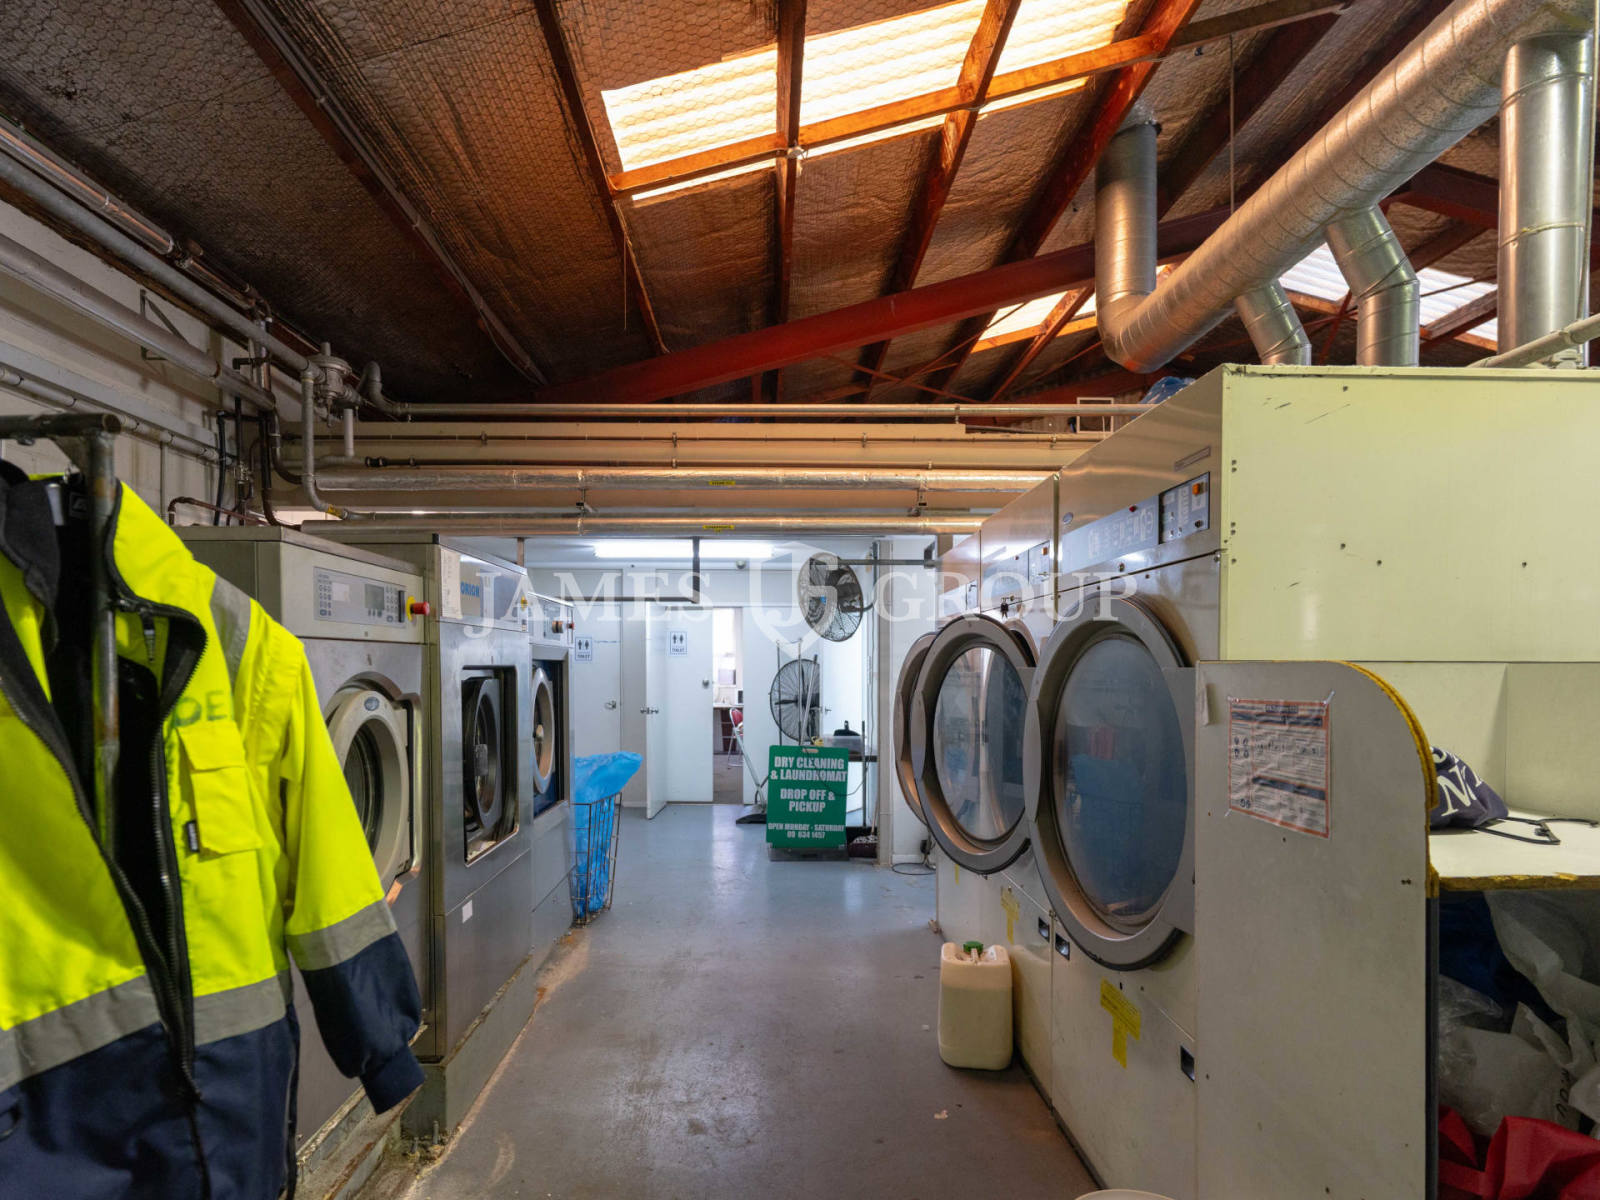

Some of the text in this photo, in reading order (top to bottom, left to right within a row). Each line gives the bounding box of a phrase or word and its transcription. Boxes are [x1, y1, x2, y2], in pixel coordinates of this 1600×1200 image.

[774, 756, 845, 770] DRY CLEANING
[770, 769, 848, 782] & LAUNDROMAT
[780, 788, 836, 801] DROP OFF &
[788, 801, 826, 813] PICKUP
[767, 822, 785, 831] OPEN
